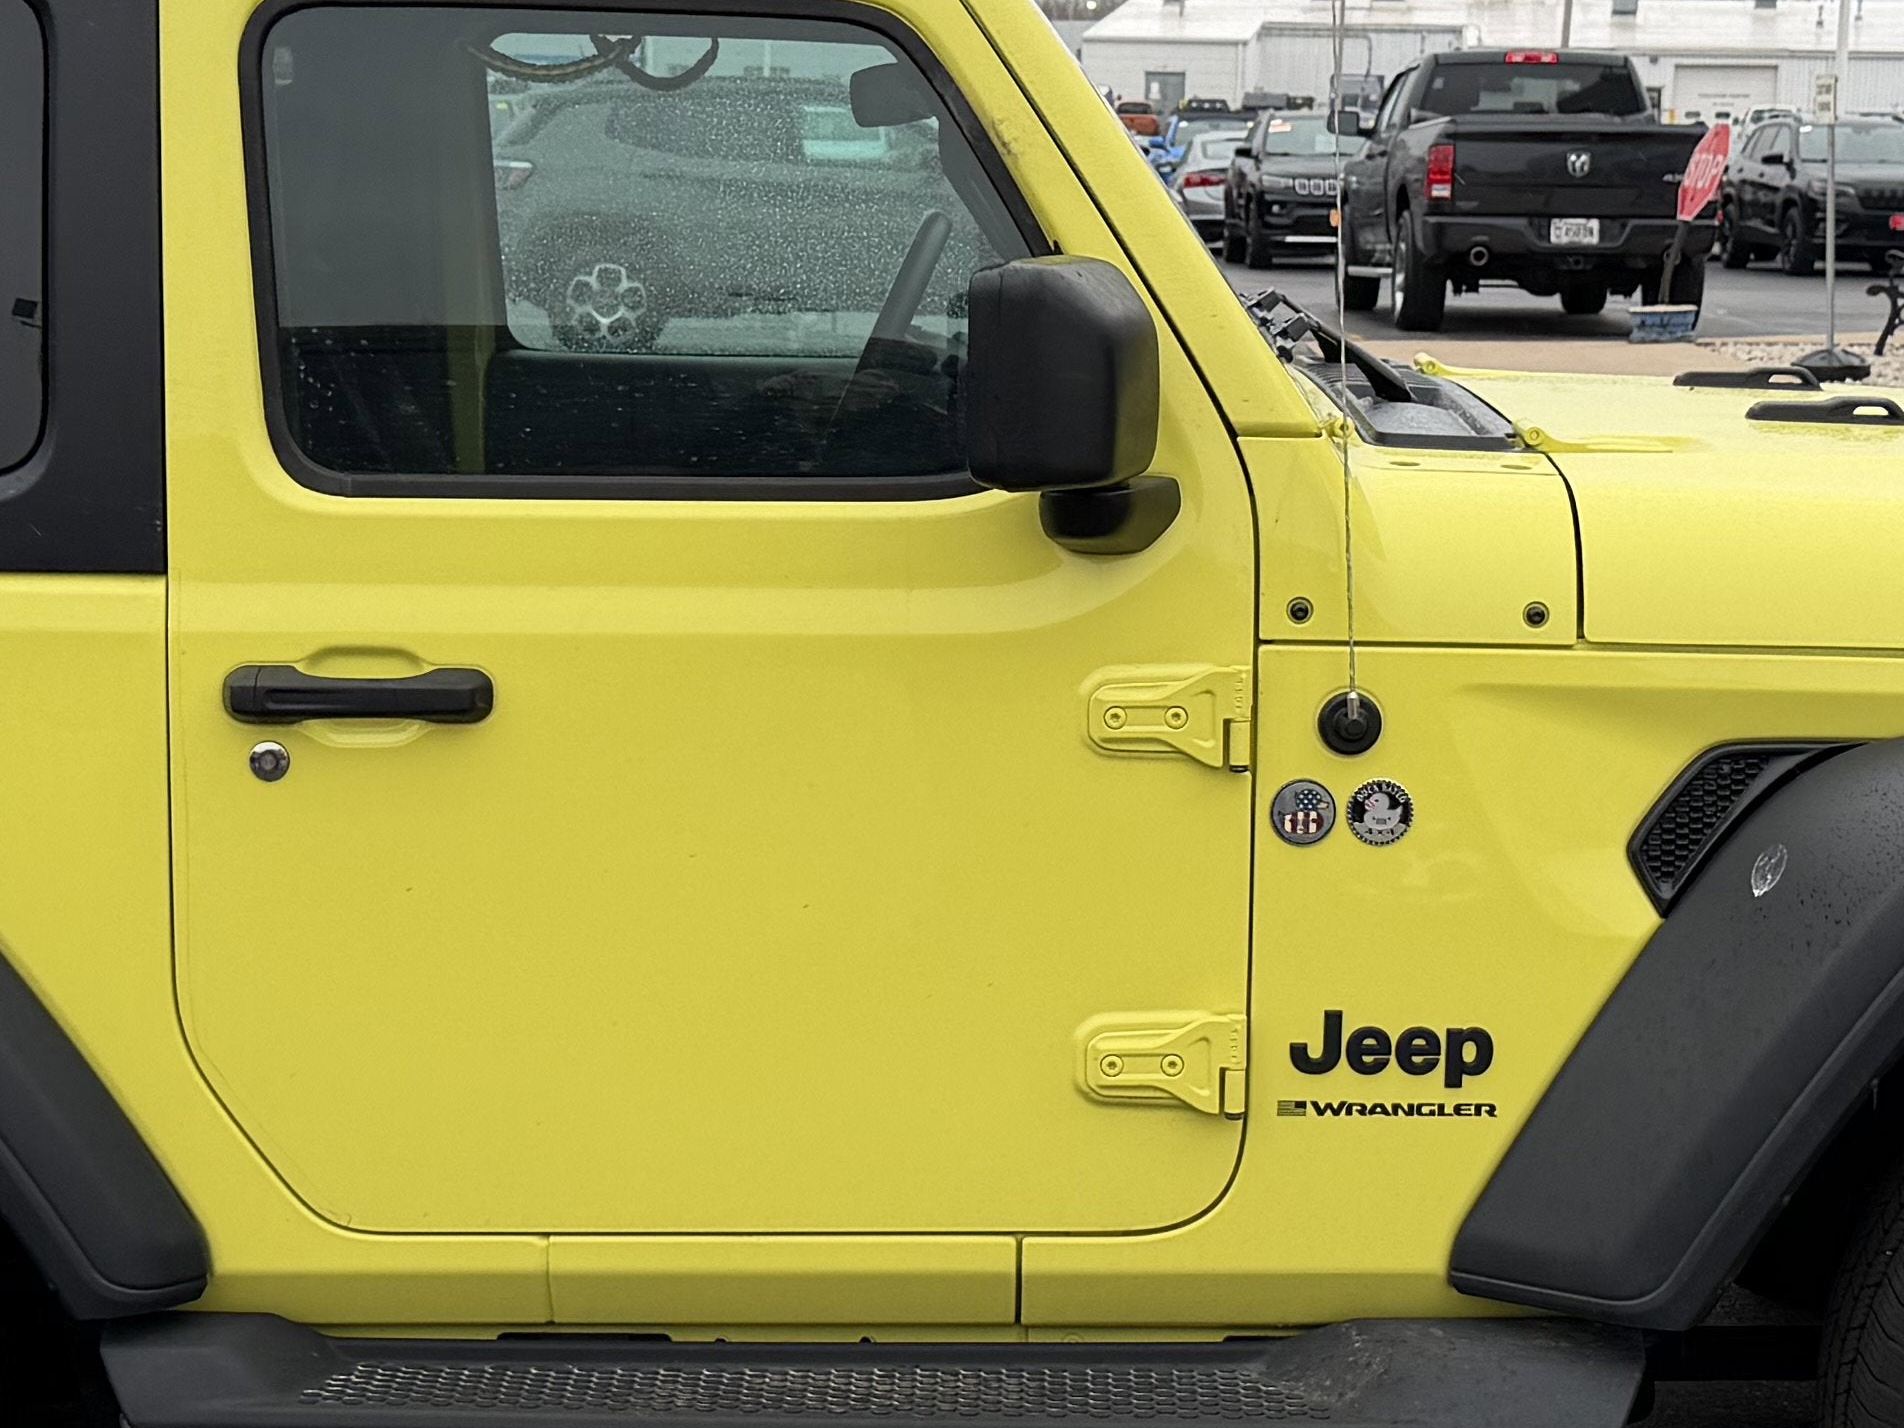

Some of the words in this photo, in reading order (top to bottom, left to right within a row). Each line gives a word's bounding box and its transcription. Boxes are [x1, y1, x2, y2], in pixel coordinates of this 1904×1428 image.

[1683, 153, 1728, 189] STOP
[1289, 1009, 1494, 1089] Jeep
[1310, 1100, 1498, 1118] WRANGLER
